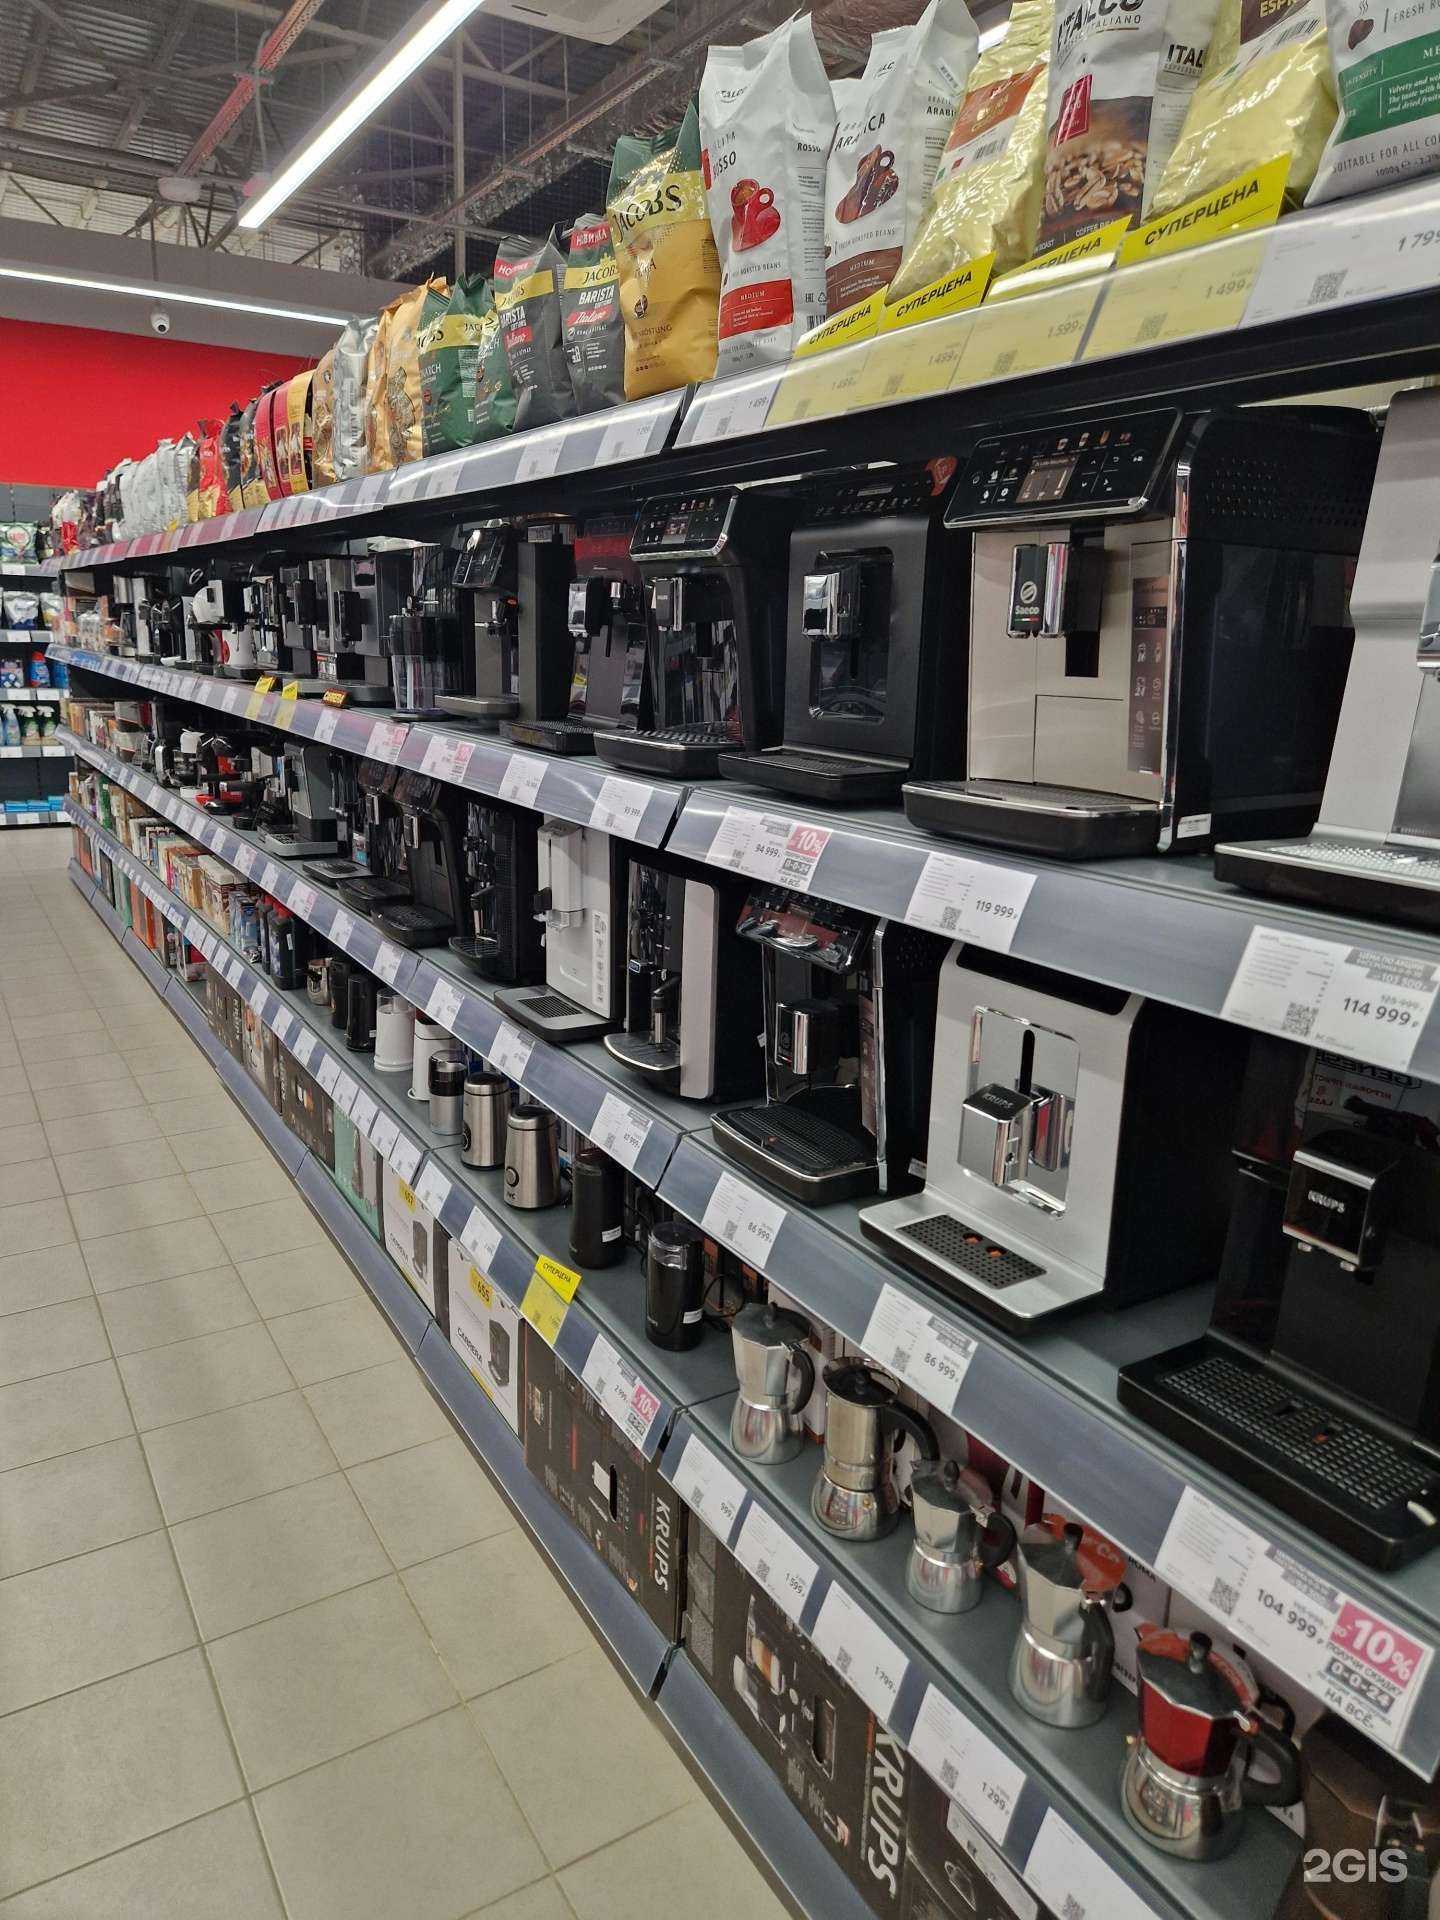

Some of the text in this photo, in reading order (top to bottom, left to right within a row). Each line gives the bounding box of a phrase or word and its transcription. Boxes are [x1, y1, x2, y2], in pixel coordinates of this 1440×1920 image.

[1393, 3, 1424, 22] FRESH
[1414, 76, 1427, 87] and
[926, 106, 957, 117] ARABI
[1387, 105, 1400, 114] and
[797, 142, 821, 153] ROSSO
[1380, 145, 1398, 158] FOR
[1402, 138, 1420, 151] ALL
[612, 184, 682, 243] JACOBS
[1144, 178, 1260, 247] СУПЕРЦЕНА
[579, 285, 615, 305] BARISTA
[896, 271, 972, 317] СУПЕРЦЕНА
[808, 304, 872, 346] СУПЕРЦЕНА
[1015, 604, 1041, 616] Saeco
[765, 847, 780, 858] 999
[976, 899, 1014, 919] 119 999
[1343, 997, 1370, 1017] 114
[1375, 1005, 1411, 1026] 999
[1308, 1190, 1345, 1214] KRUPS
[542, 1262, 572, 1284] СУПЕРЦЕНА
[923, 1352, 957, 1380] 86 999
[653, 1496, 671, 1594] KRUPS
[1256, 1588, 1285, 1616] 104
[1287, 1608, 1318, 1639] 999
[1331, 1663, 1393, 1708] 0-0-24
[1325, 1688, 1344, 1706] НА
[867, 1732, 905, 1901] KRUPS
